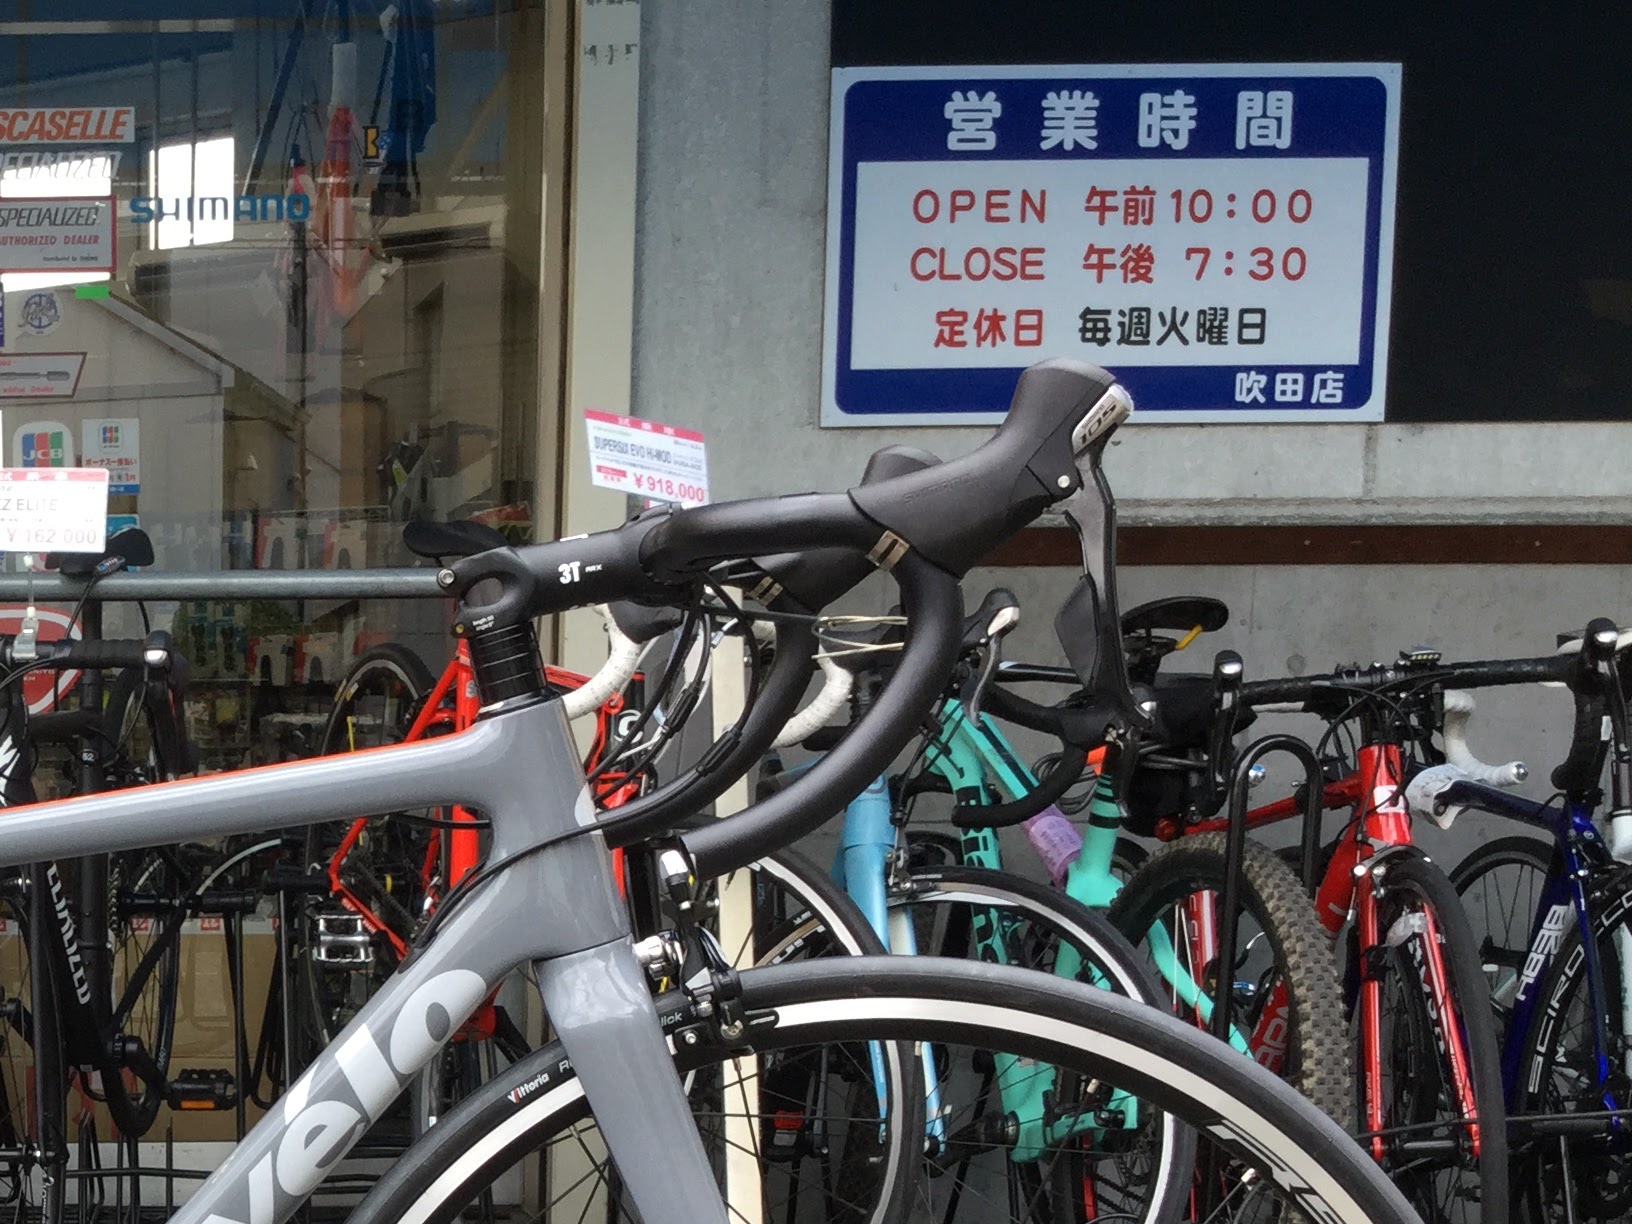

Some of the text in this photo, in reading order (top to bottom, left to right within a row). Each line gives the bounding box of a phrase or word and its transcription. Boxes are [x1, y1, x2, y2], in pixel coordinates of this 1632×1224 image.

[943, 89, 1294, 152] 営業時間
[129, 193, 310, 224] SHIMANO
[912, 188, 1047, 223] OPEN
[63, 235, 99, 245] DEALER
[910, 243, 1307, 284] CLOSE 午後 7:30
[933, 306, 1267, 348] 定休日 毎週火曜日
[1234, 370, 1344, 405] 吹田店
[1079, 402, 1118, 446] 105
[23, 448, 64, 460] JCB
[630, 443, 645, 459] EVO
[558, 561, 581, 585] 3T
[507, 1071, 550, 1104] Vittoria
